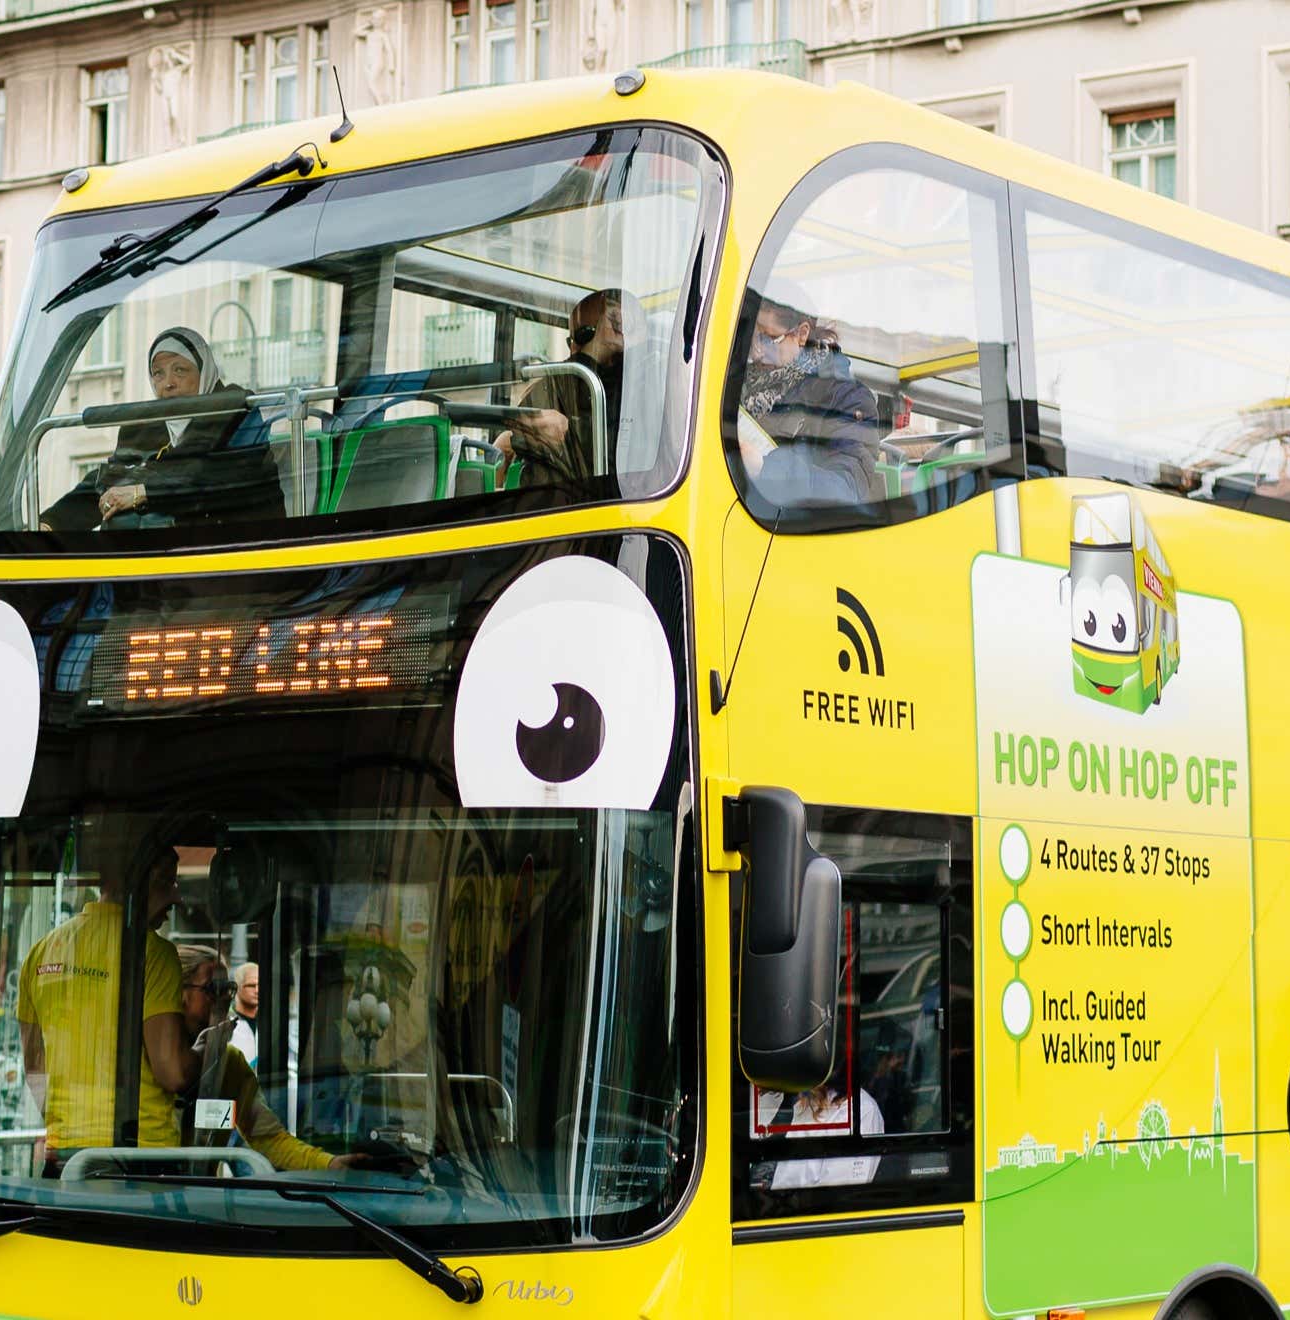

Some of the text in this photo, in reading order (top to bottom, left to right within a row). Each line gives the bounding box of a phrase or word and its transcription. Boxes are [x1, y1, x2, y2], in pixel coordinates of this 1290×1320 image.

[126, 618, 393, 699] RED LINE
[803, 689, 916, 730] FREE WIFI
[993, 731, 1238, 807] HOP ON HOP OFF
[1040, 838, 1210, 885] 4 Routes & 37 Stops
[1041, 914, 1173, 948] Short Intervals
[1042, 990, 1146, 1021] Incl. Guided
[1041, 1032, 1162, 1071] Walking Tour
[492, 1279, 574, 1306] Urbis
